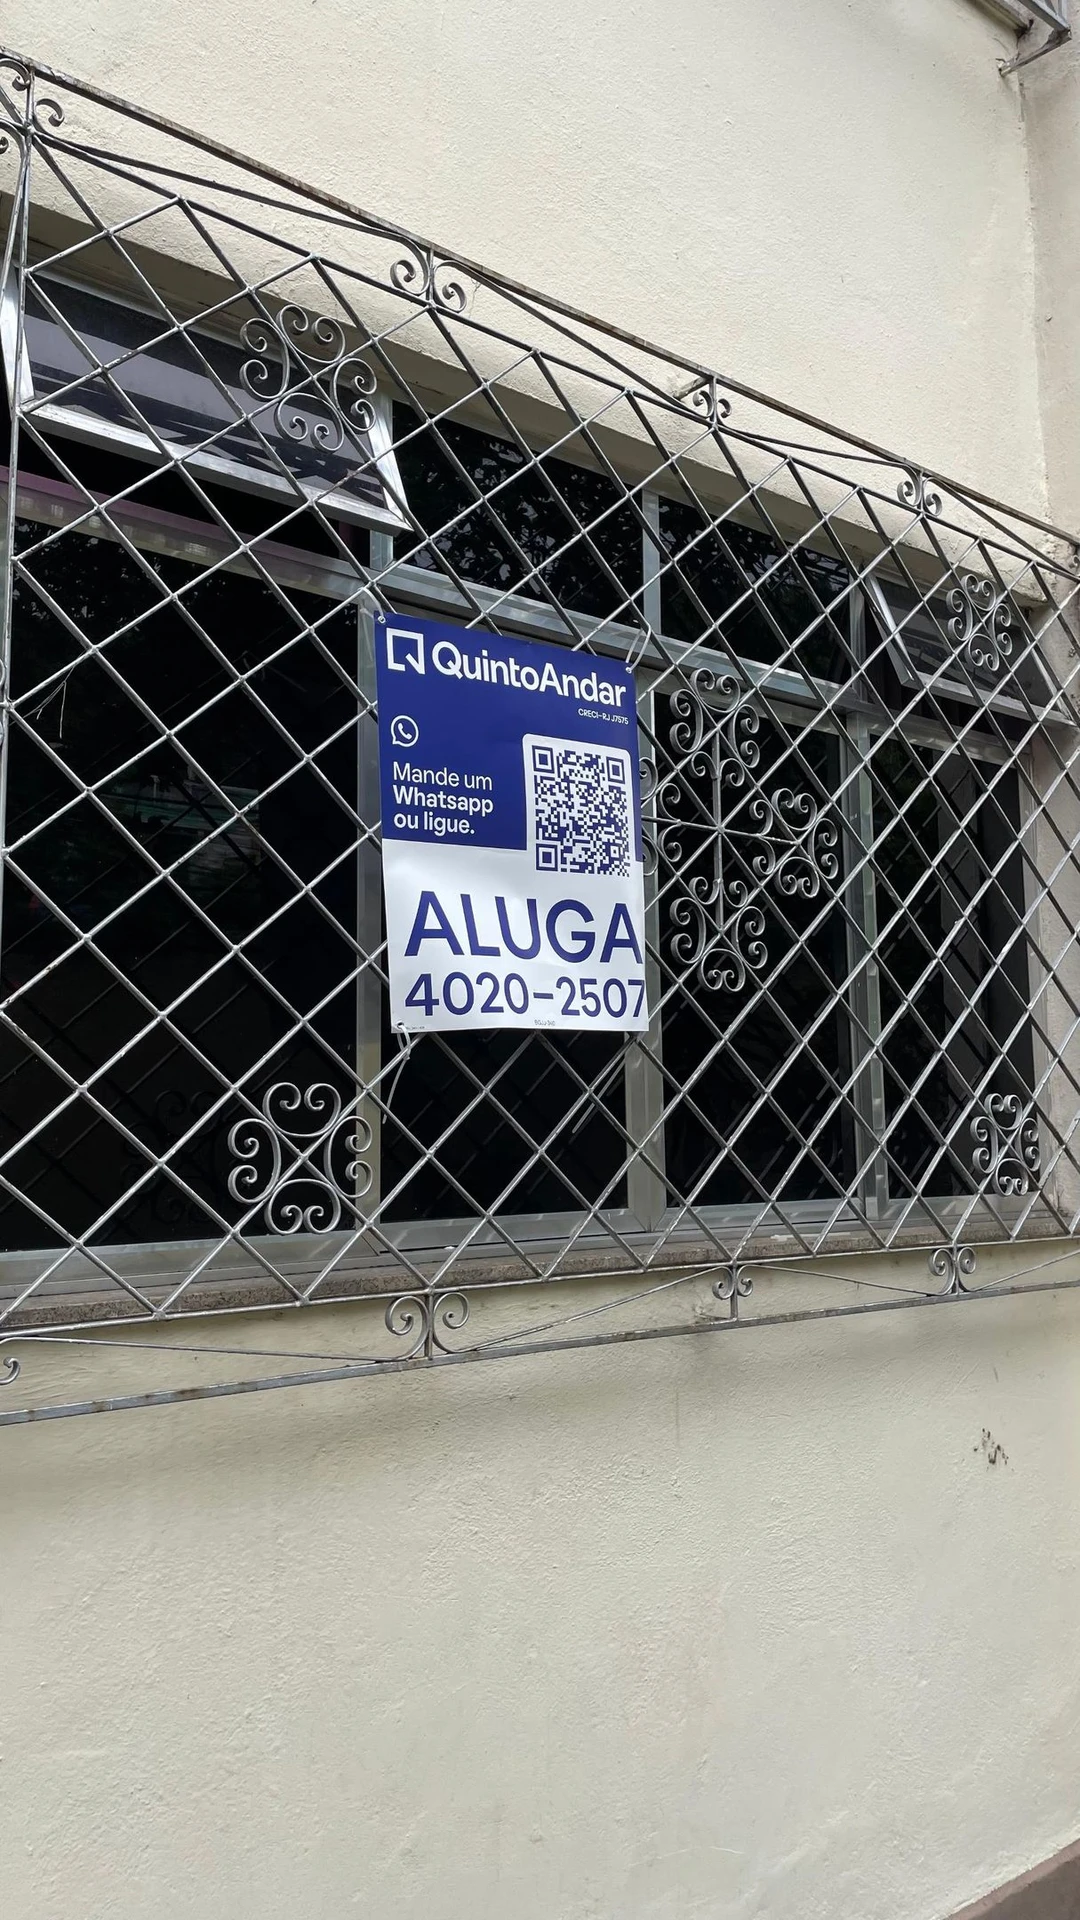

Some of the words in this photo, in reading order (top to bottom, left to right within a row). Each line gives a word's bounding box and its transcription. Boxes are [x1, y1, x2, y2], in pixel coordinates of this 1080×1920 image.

[432, 641, 626, 706] QuintoAndar
[393, 762, 460, 788] Mande
[464, 774, 493, 790] um
[393, 785, 494, 816] Whatsapp
[393, 813, 419, 829] ou
[424, 812, 475, 836] ligue.
[404, 890, 643, 964] ALUGA
[405, 972, 645, 1018] 4020-2507
